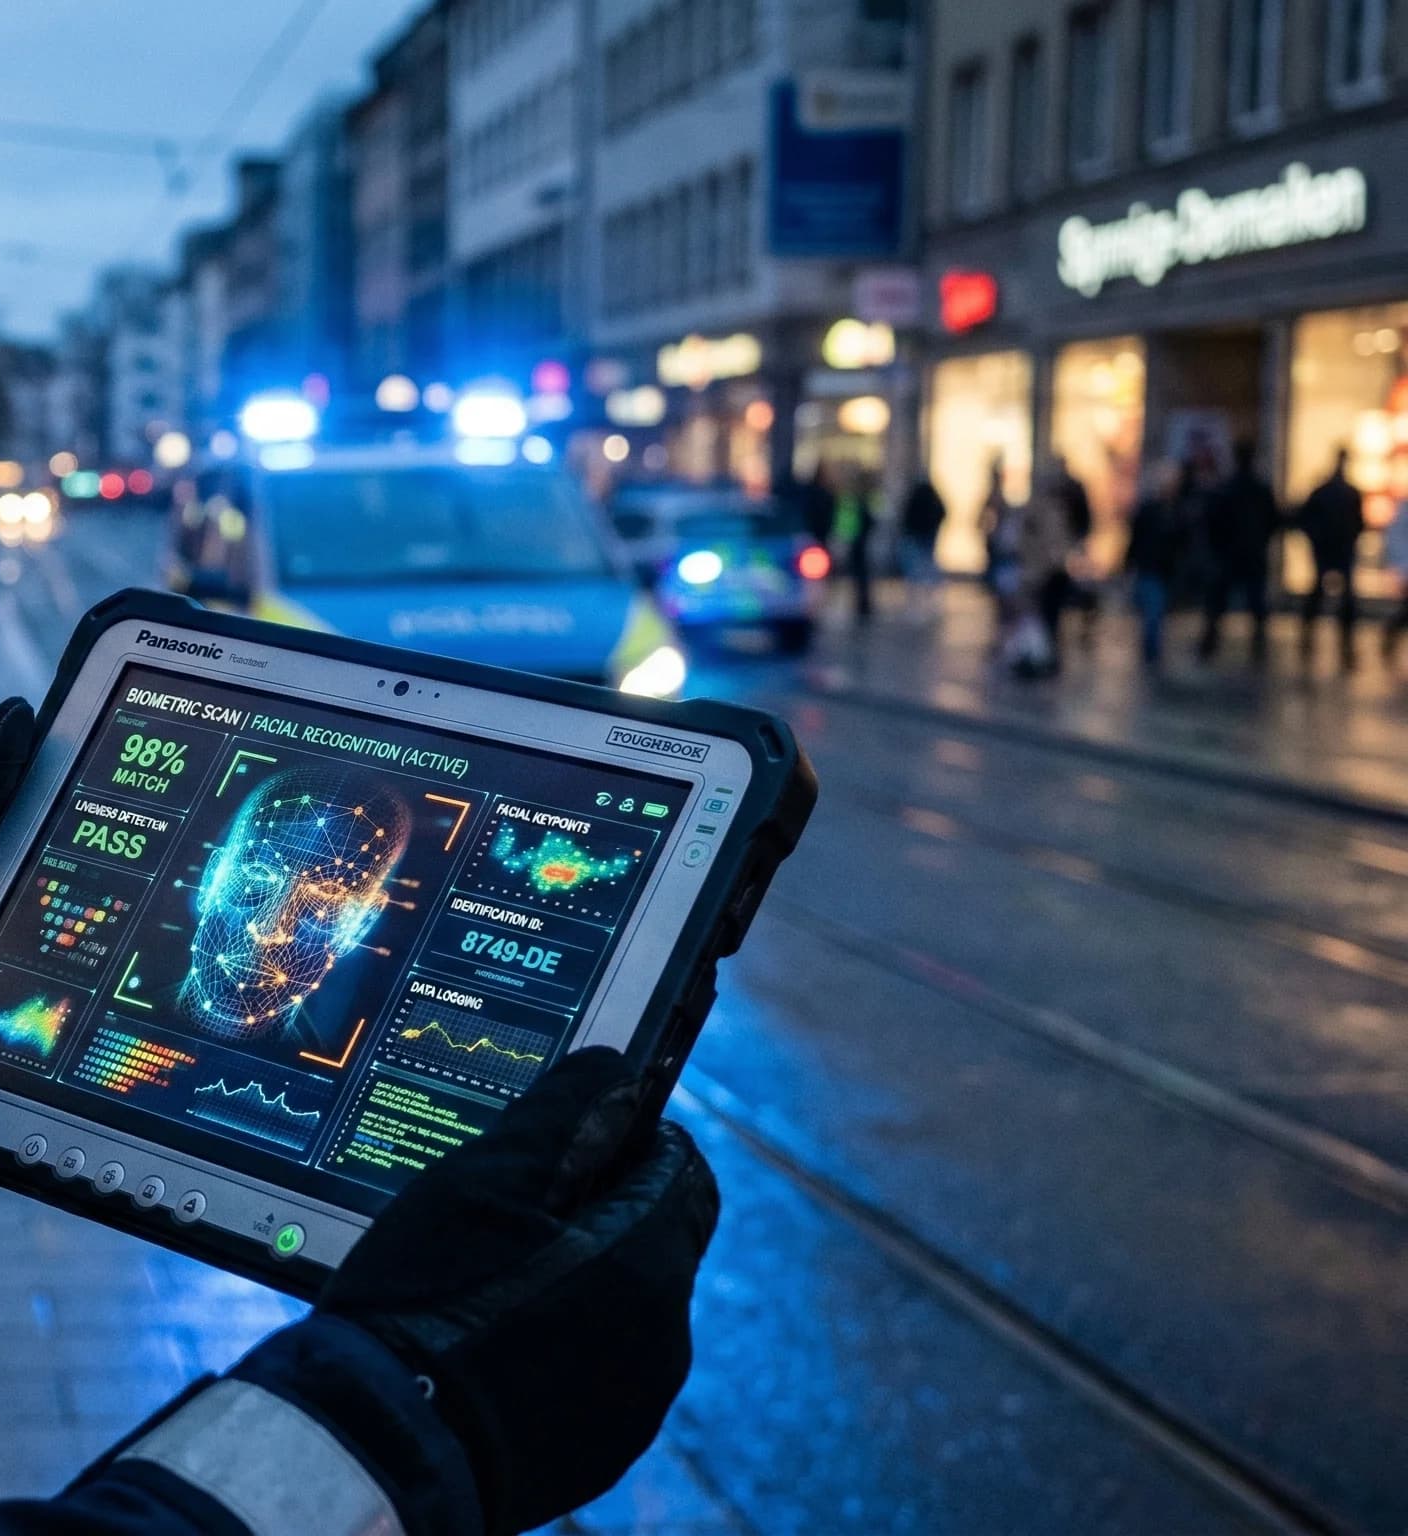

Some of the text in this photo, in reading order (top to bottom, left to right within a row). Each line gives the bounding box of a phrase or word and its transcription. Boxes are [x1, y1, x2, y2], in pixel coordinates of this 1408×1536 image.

[135, 629, 224, 660] Panasonic
[125, 687, 202, 717] BIOMETRIC
[201, 704, 242, 726] SCAN
[250, 714, 299, 739] FACIAL
[301, 726, 402, 761] RECOGNITION
[401, 746, 469, 779] (ACTIVE)
[611, 730, 706, 759] TOUGHBOOK
[120, 734, 189, 775] 98%
[111, 767, 171, 794] MATCH
[496, 803, 531, 822] FACIAL
[72, 820, 147, 859] PASS
[450, 897, 529, 928] IDENTIFICATION
[460, 930, 562, 974] 8749-DE
[410, 981, 436, 998] DATA
